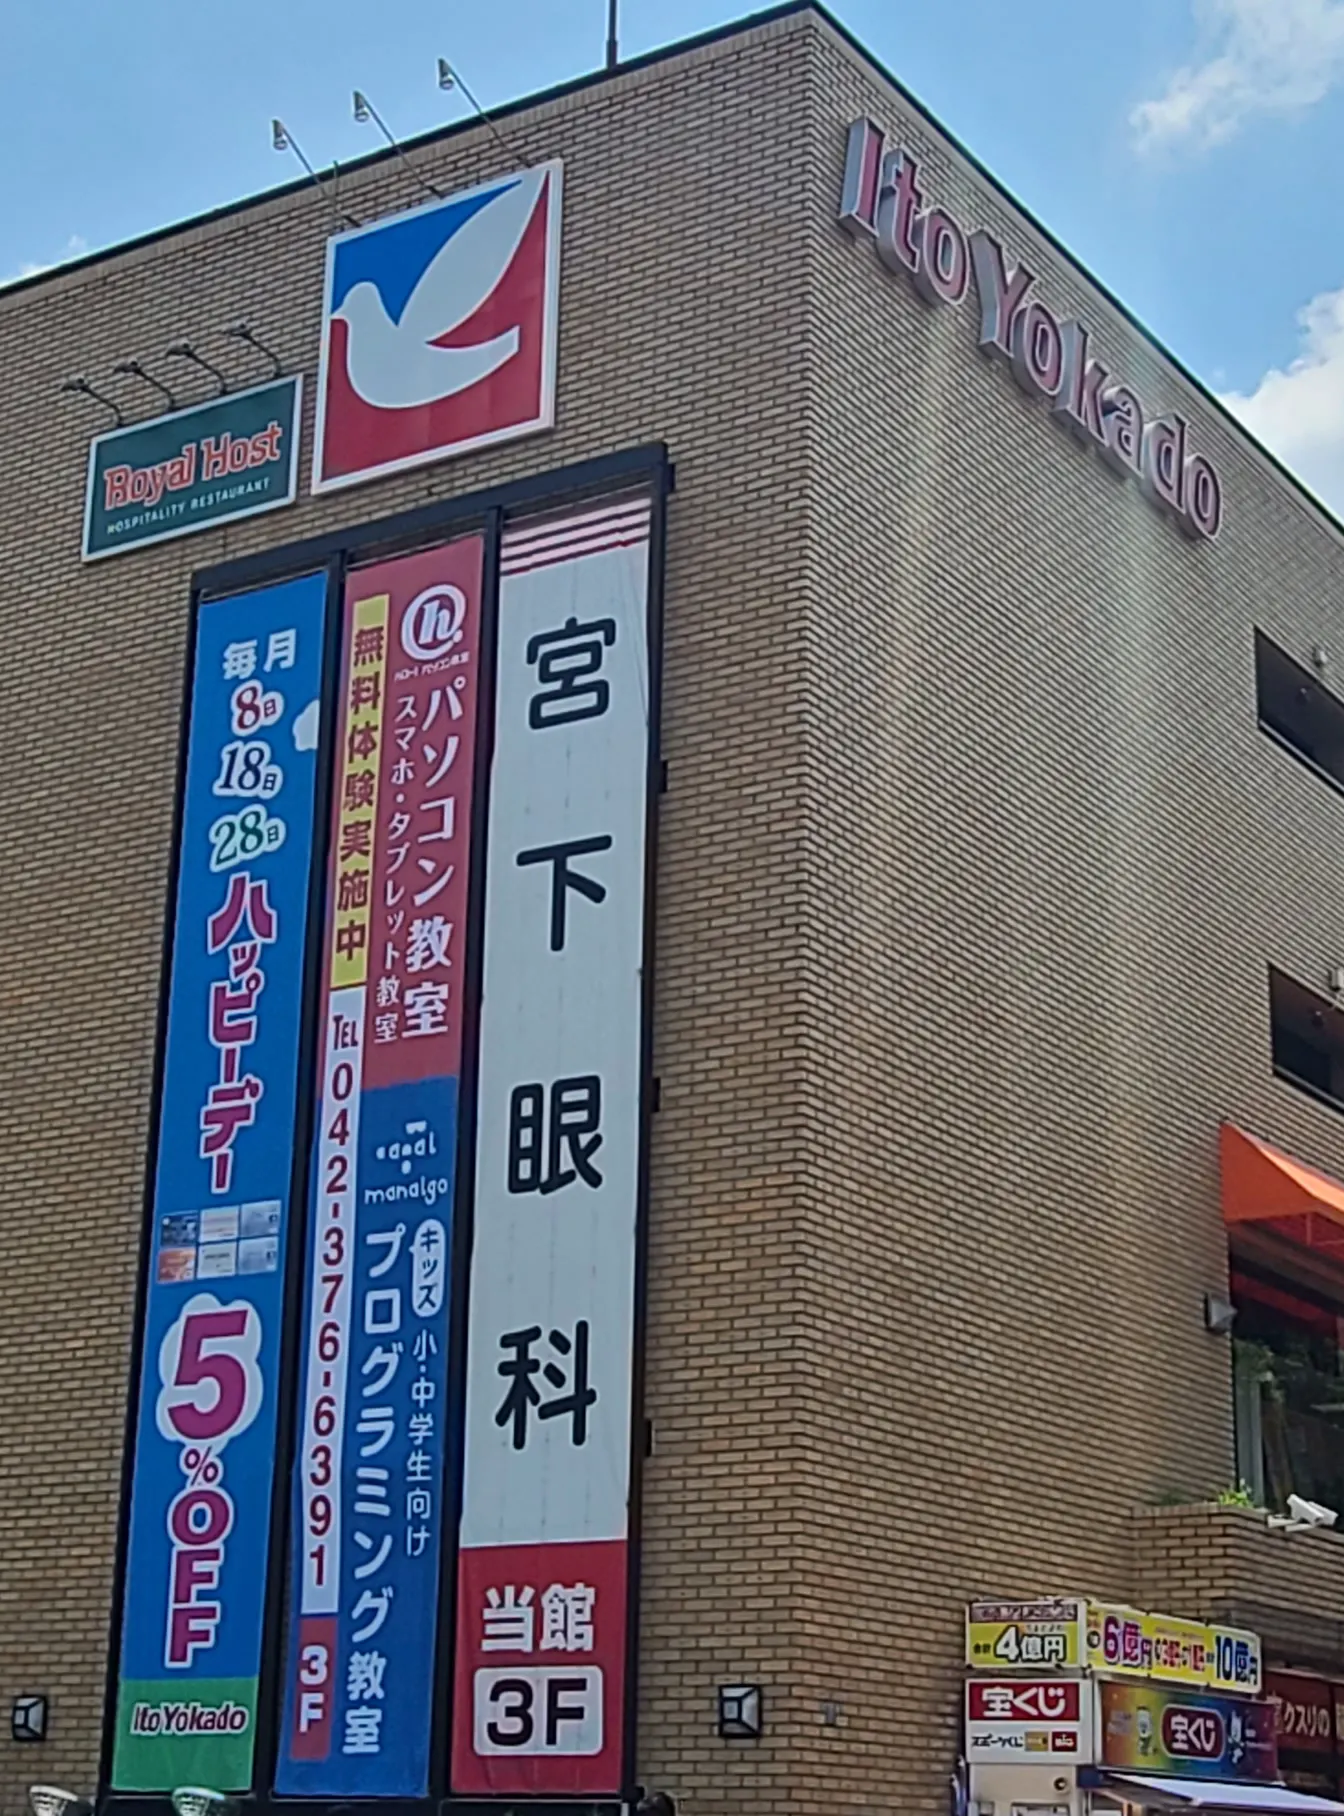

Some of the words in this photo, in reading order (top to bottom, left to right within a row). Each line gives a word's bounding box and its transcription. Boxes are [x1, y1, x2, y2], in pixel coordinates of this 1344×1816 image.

[839, 113, 1222, 540] ItoYokado
[104, 443, 196, 511] Royal
[202, 420, 283, 482] Host
[107, 502, 186, 535] HOSPITALITY
[190, 477, 271, 511] RESTAURANT
[222, 628, 297, 680] 毎月
[233, 683, 280, 733] 8日
[216, 744, 280, 795] 18日
[336, 626, 384, 961] 無料体験実施中
[212, 807, 283, 868] 28日
[374, 695, 416, 1044] スマホ・タブレット教室
[402, 676, 467, 1038] パソコン教室
[201, 872, 277, 1194] ハッピーデー
[332, 1014, 358, 1050] TEL
[495, 617, 617, 1452] 宮下眼科
[364, 1176, 448, 1205] manalgo
[416, 1226, 439, 1310] キッズ
[309, 1062, 354, 1588] 042-376-6391
[406, 1329, 438, 1557] 小・中学生向け
[342, 1222, 405, 1755] プログラミング教室
[480, 1580, 596, 1654] 当館
[130, 1701, 248, 1736] ItoYokado
[298, 1645, 329, 1734] 3F
[485, 1676, 588, 1748] 3F
[982, 1686, 1066, 1718] 宝くじ
[1169, 1713, 1217, 1752] 宝くじ
